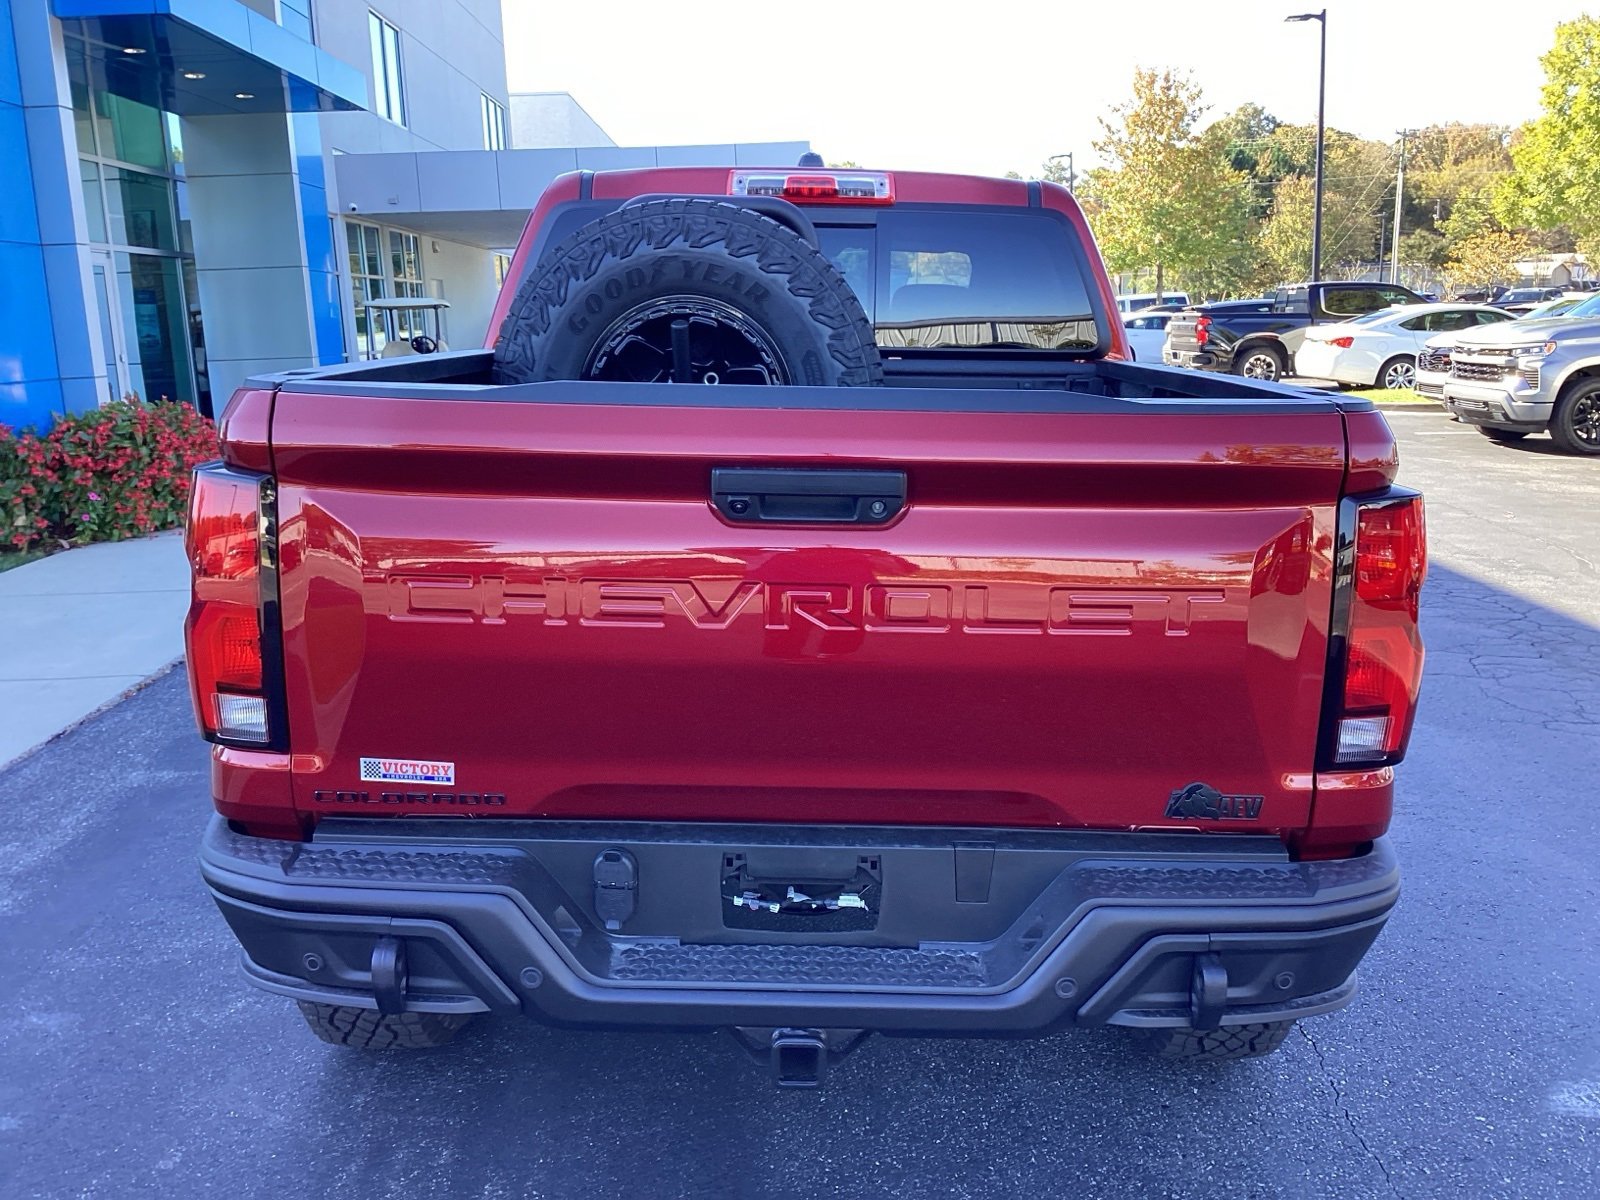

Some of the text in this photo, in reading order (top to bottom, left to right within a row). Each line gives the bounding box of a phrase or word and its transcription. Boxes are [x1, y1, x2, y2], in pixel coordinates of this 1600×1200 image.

[387, 573, 1226, 637] CHEVROLET
[382, 761, 451, 776] VICTORY
[314, 790, 506, 806] COLORADO
[1219, 796, 1262, 819] AEV
